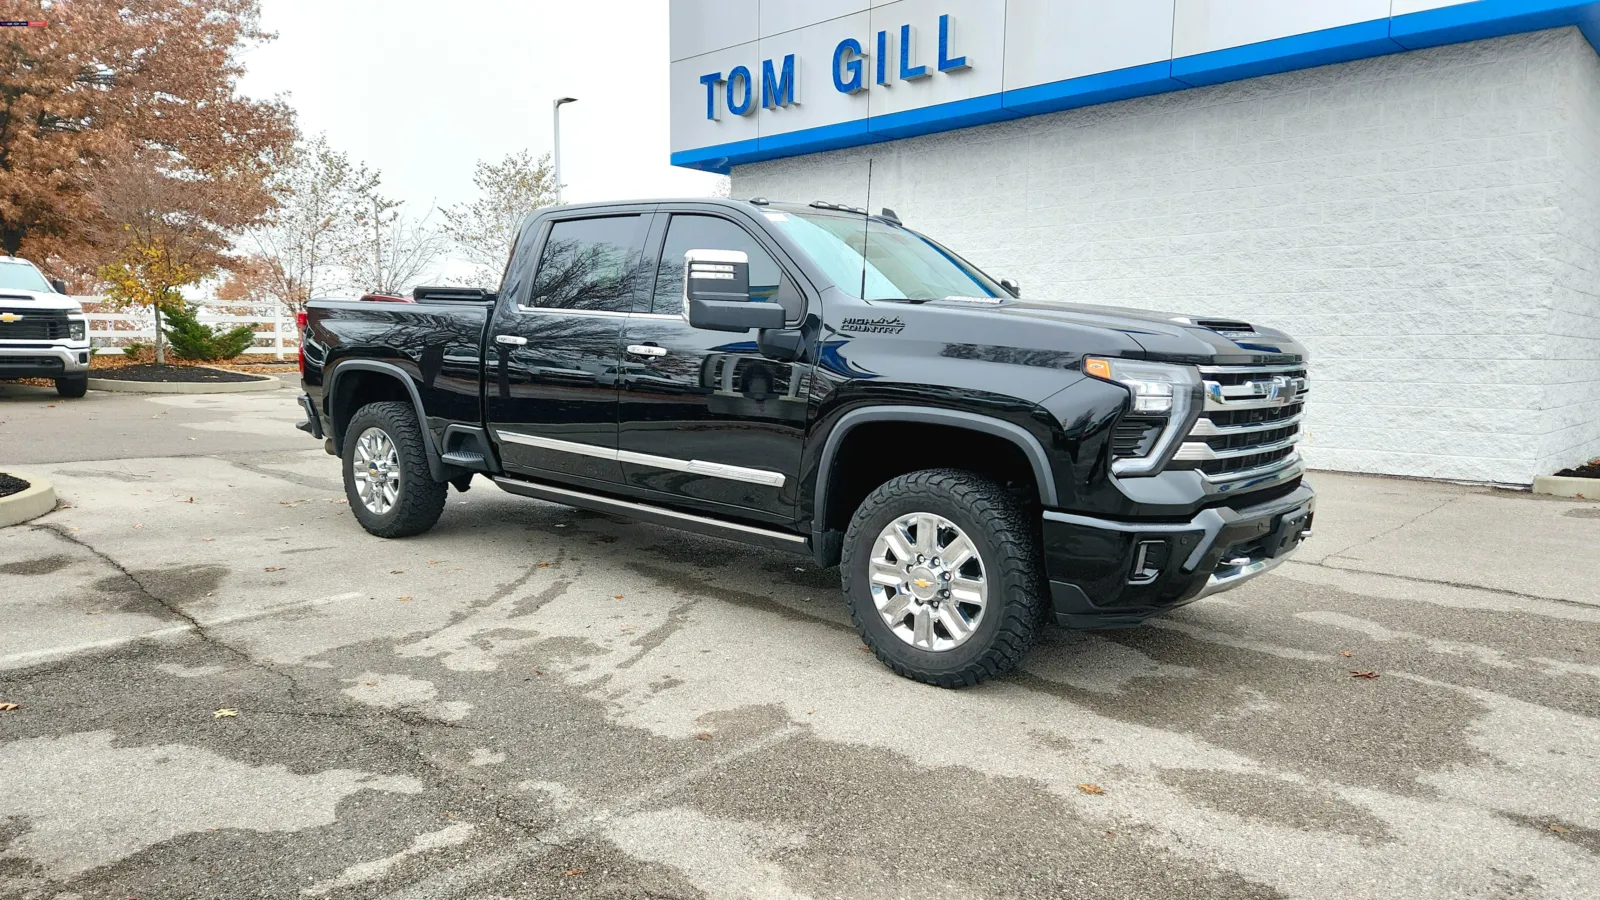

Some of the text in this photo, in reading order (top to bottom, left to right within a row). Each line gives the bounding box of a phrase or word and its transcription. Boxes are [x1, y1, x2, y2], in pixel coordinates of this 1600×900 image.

[700, 14, 972, 121] TOM GILL
[842, 317, 873, 325] HIGH
[840, 324, 904, 334] COUNTRY
